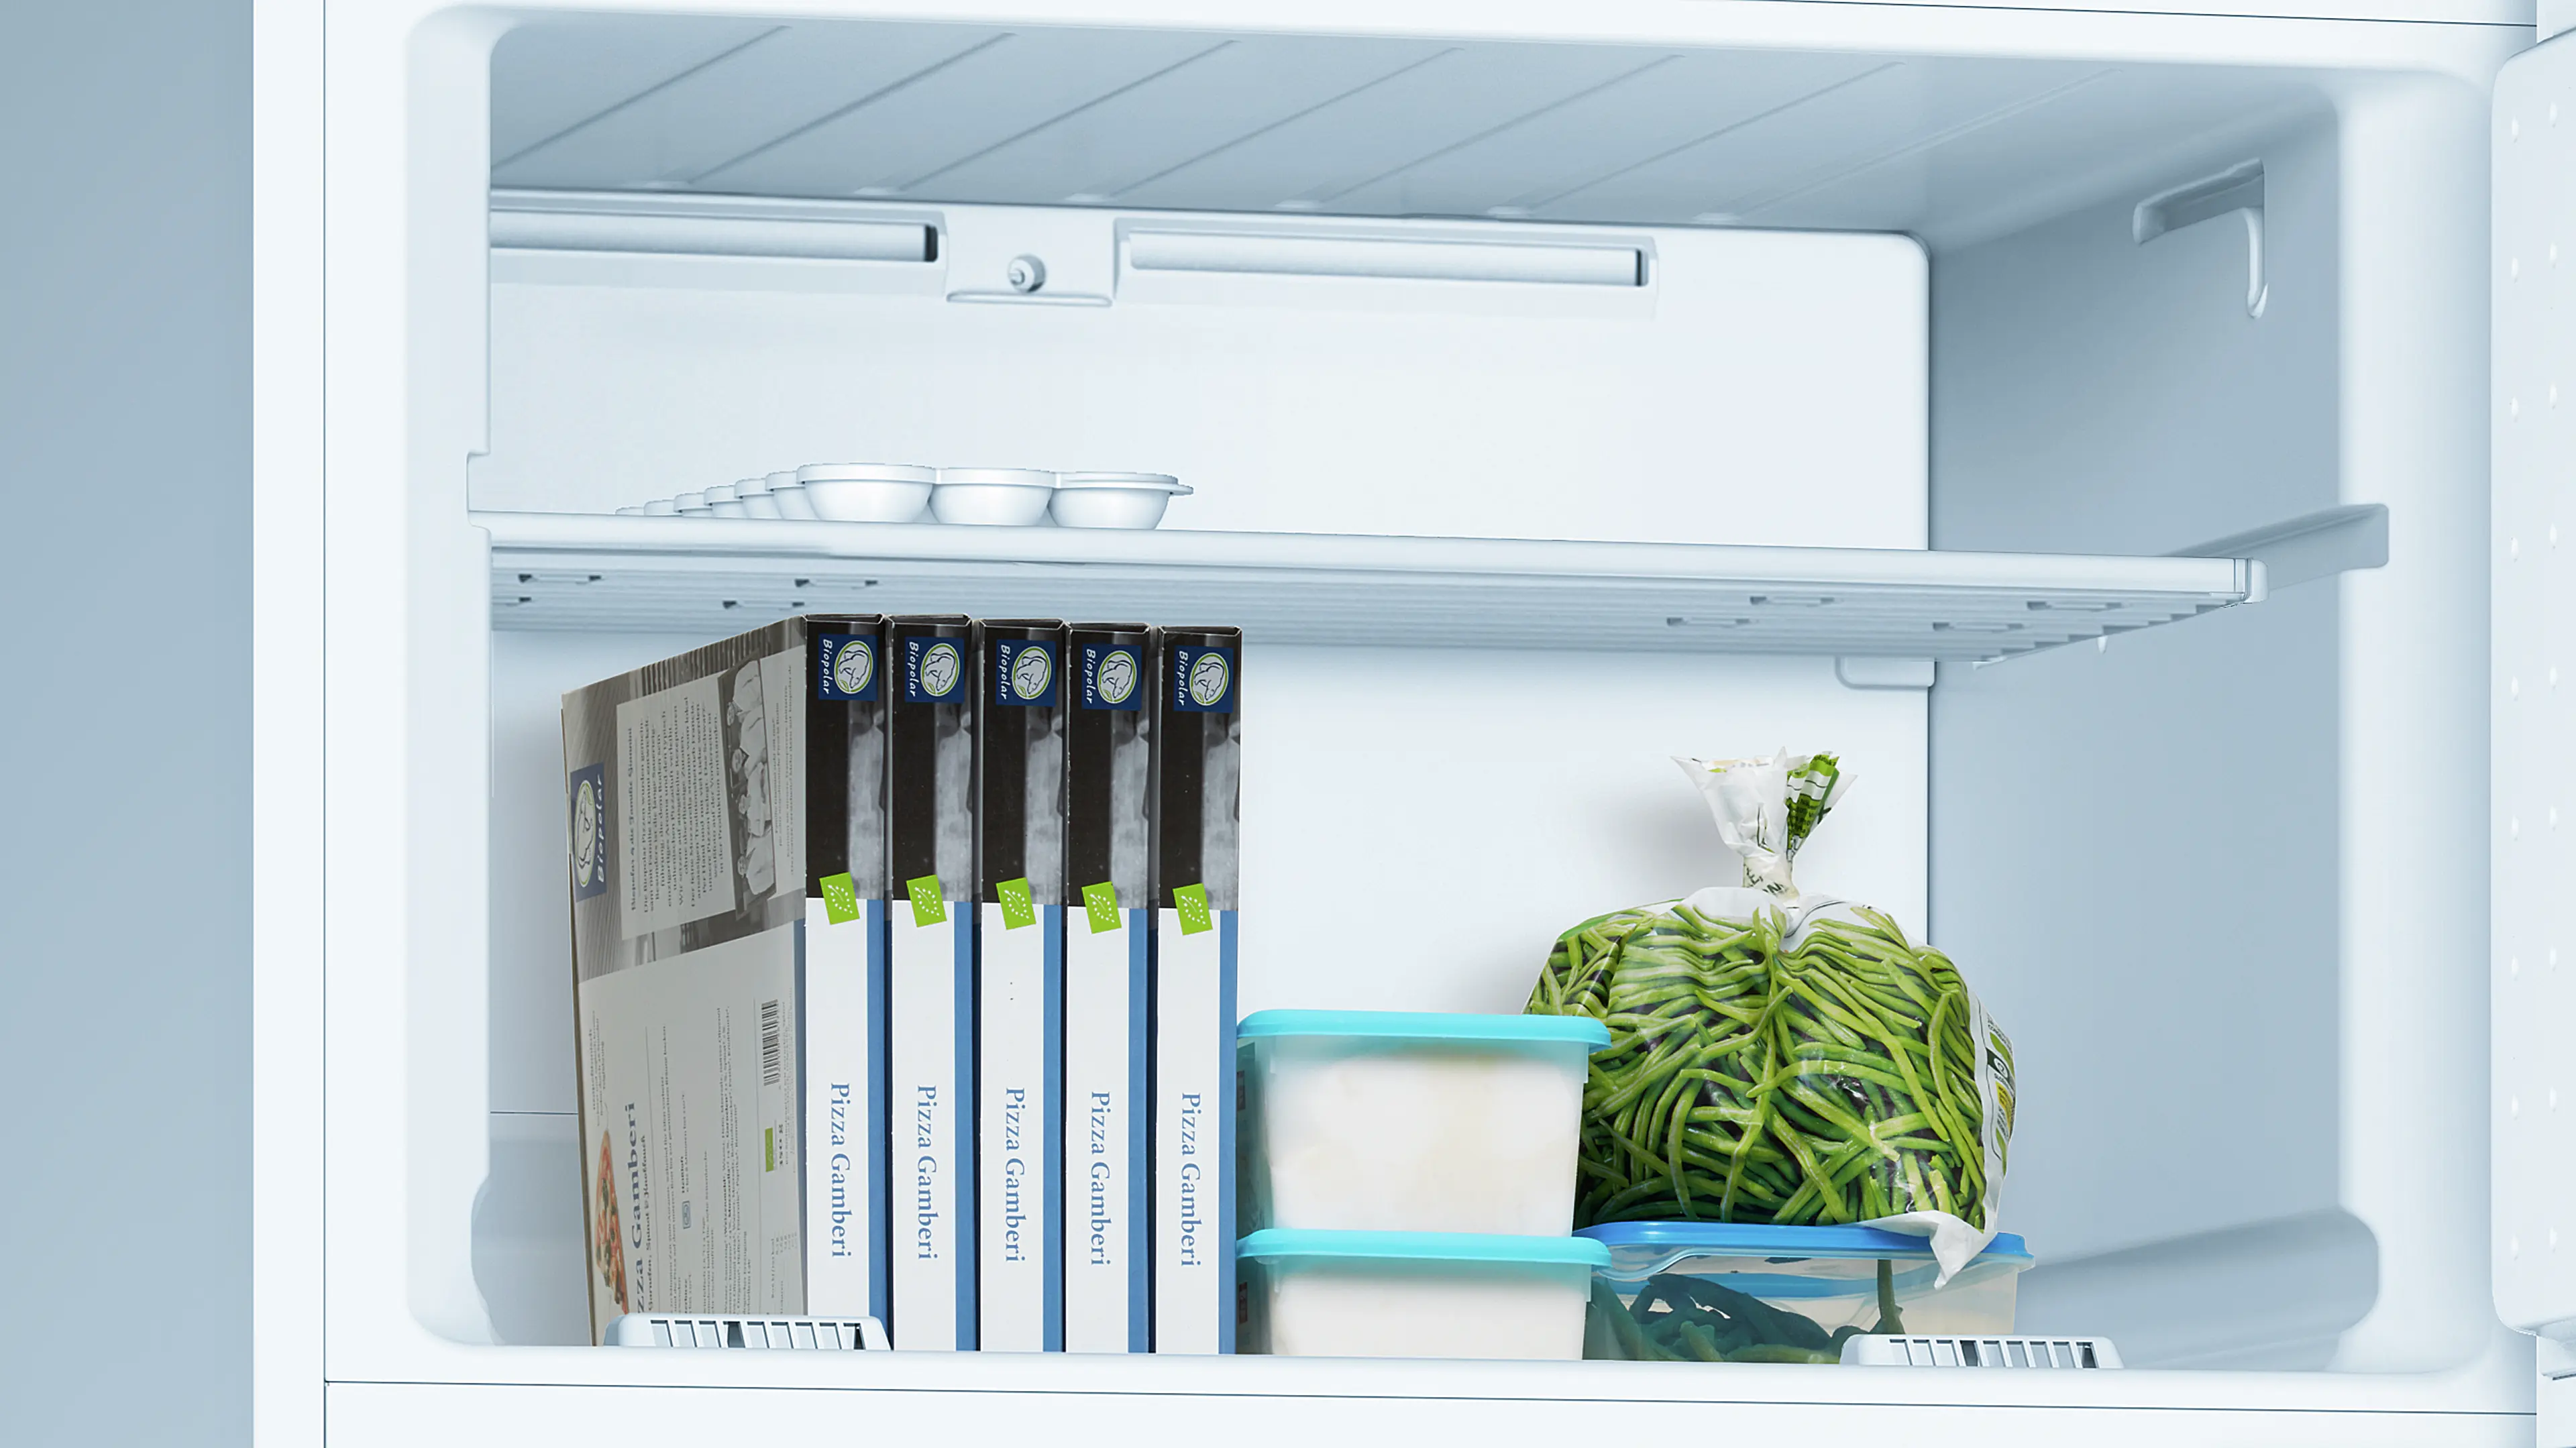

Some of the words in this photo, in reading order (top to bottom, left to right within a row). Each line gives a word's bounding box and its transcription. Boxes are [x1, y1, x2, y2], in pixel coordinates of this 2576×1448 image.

[822, 639, 832, 695] Biopolar
[908, 642, 918, 697] Biopolar
[1000, 645, 1010, 700] Biopolar
[1085, 649, 1095, 704] Biopolar
[1178, 651, 1188, 706] Biopolar
[594, 773, 604, 883] Biopolar
[830, 1083, 851, 1146] Pizza
[917, 1085, 938, 1149] Pizza
[1006, 1088, 1026, 1151] Pizza
[1091, 1091, 1112, 1155] Pizza
[1181, 1093, 1202, 1156] Pizza
[625, 1101, 643, 1249] Gamberi
[830, 1153, 853, 1257] Gamberi
[917, 1156, 939, 1260] Gamberi
[1005, 1158, 1027, 1262] Gamberi
[1091, 1162, 1112, 1265] Gamberi
[1181, 1163, 1203, 1266] Gamberi
[634, 1257, 645, 1313] zza
